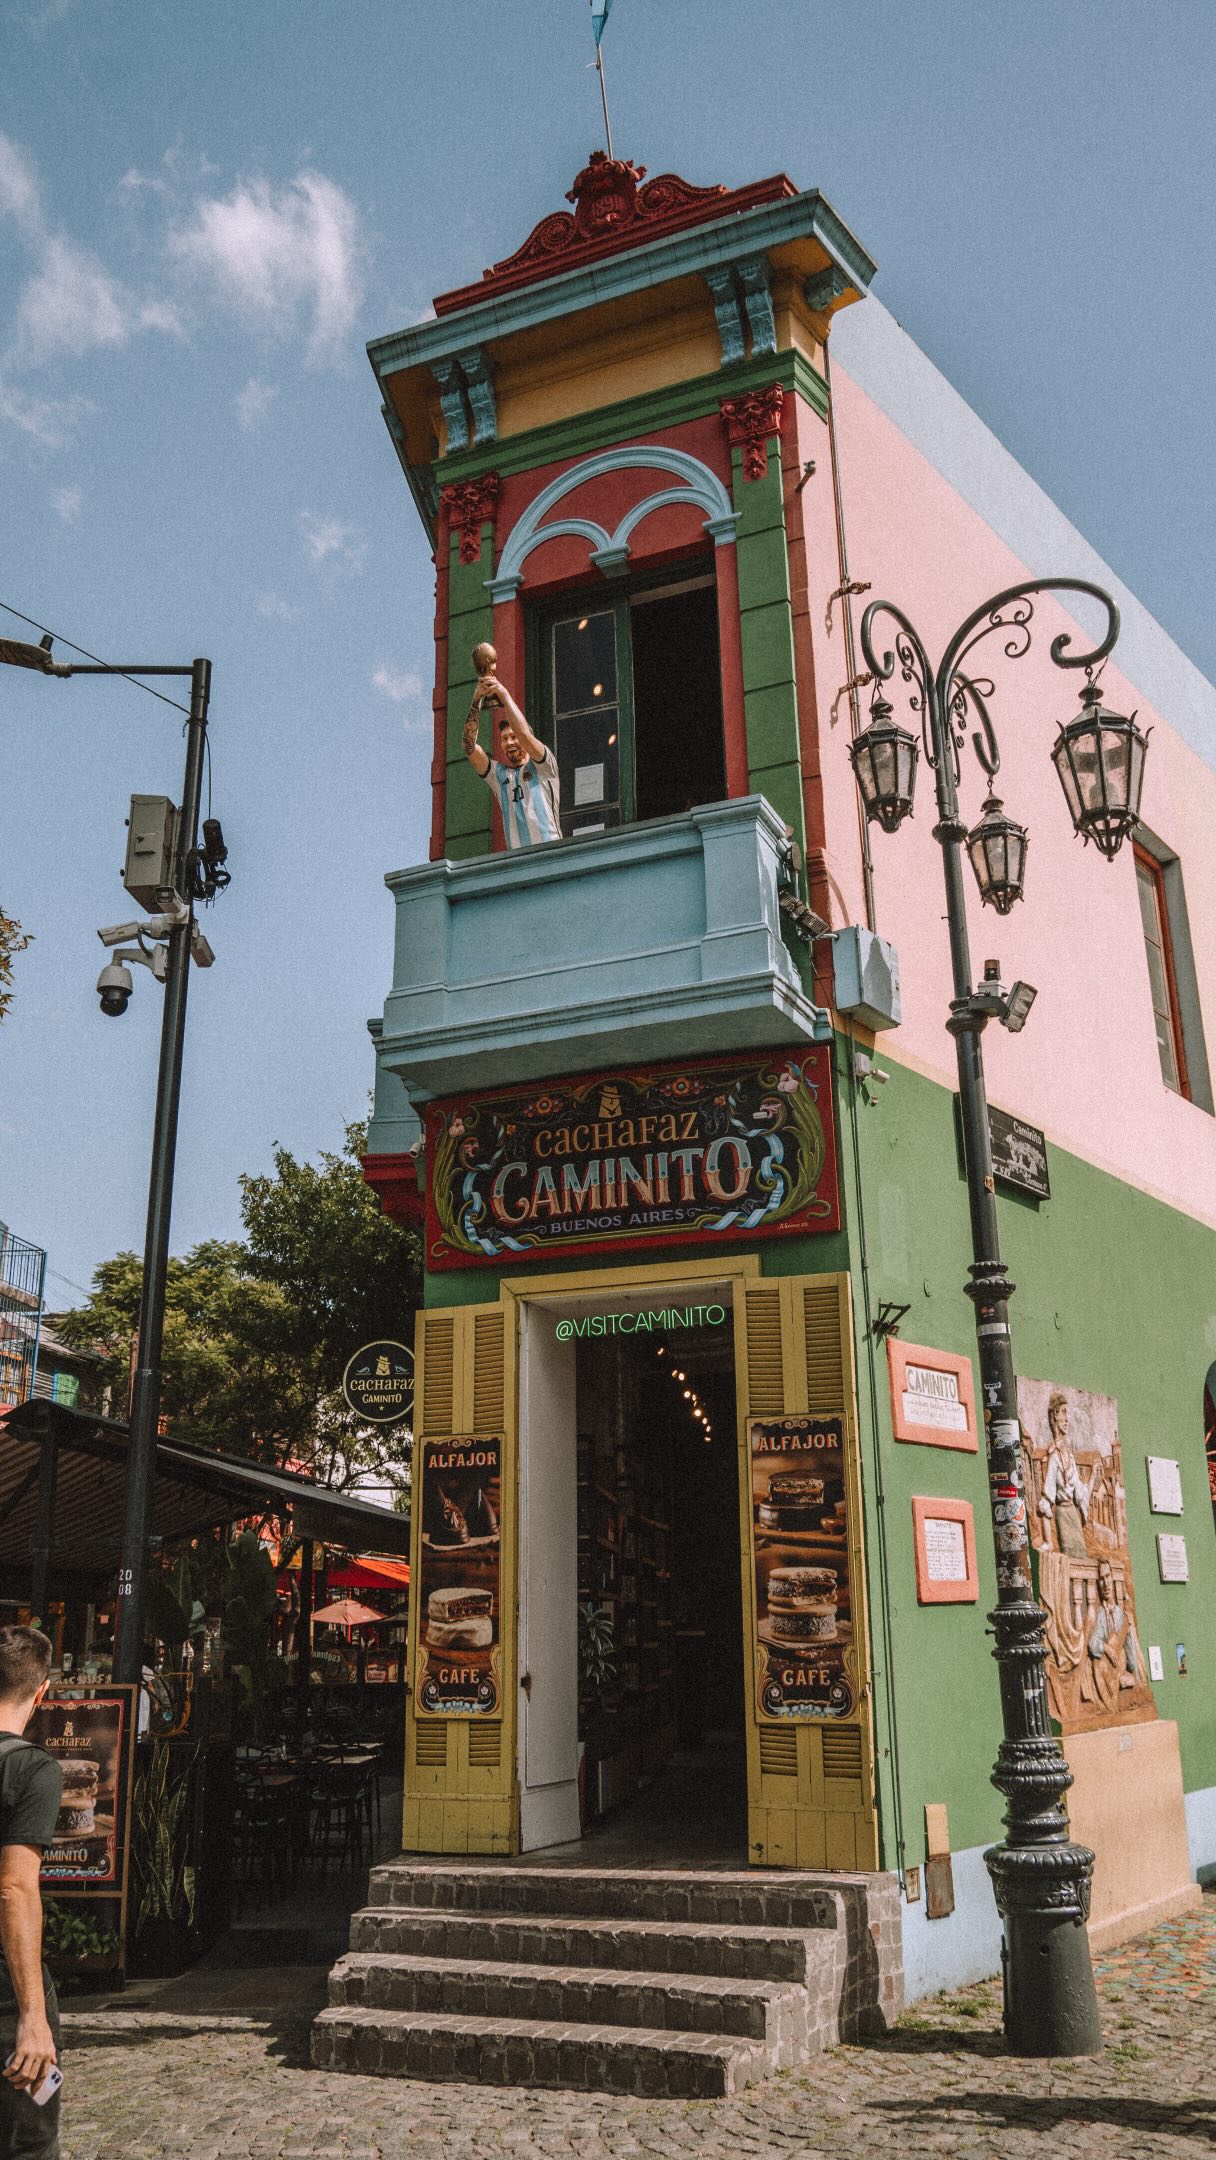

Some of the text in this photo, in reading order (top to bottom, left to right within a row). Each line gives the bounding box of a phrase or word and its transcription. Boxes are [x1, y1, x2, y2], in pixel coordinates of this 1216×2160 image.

[492, 1135, 753, 1224] CAMINITO
[550, 1208, 686, 1234] BUENOS AIRES
[555, 1304, 726, 1342] @VISITCAMINITO
[907, 1368, 957, 1399] CAMINITO
[362, 1393, 402, 1404] CAMINITO
[759, 1433, 839, 1451] ALFAJOR
[428, 1451, 497, 1468] ALFAJOR
[119, 1569, 133, 1581] 20
[118, 1583, 132, 1595] 08
[439, 1668, 480, 1685] CAFE
[782, 1669, 831, 1687] CAFE
[43, 1848, 89, 1862] AMINITO
